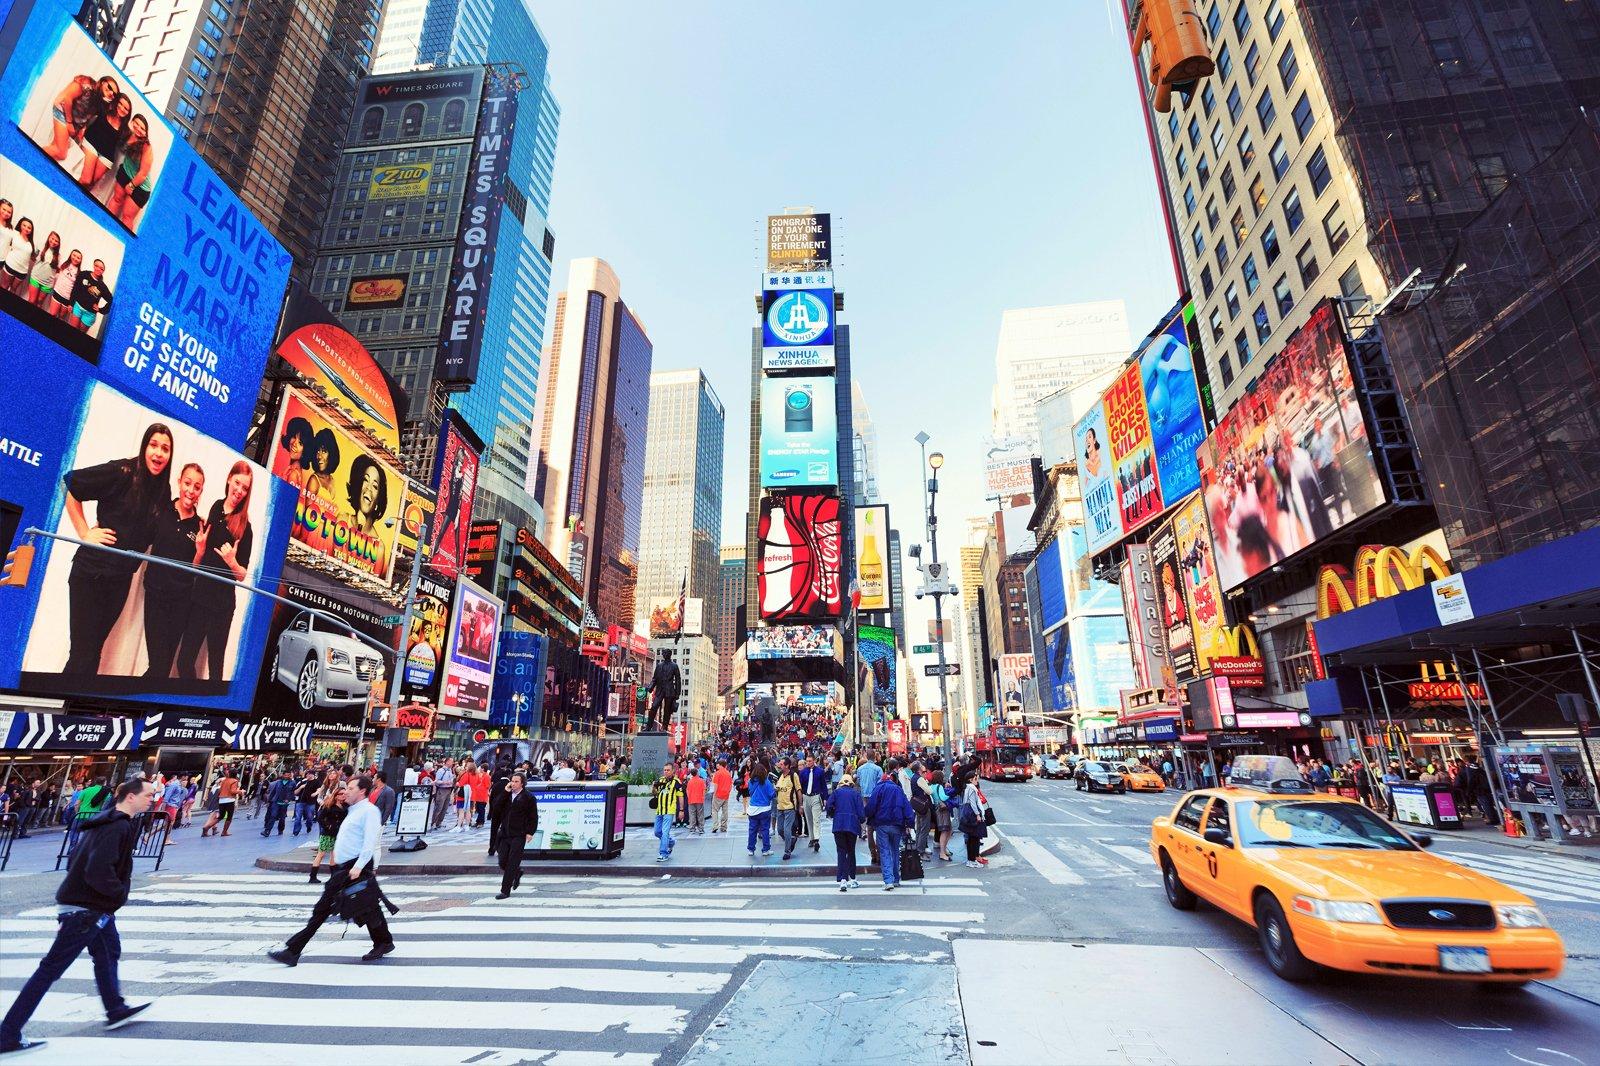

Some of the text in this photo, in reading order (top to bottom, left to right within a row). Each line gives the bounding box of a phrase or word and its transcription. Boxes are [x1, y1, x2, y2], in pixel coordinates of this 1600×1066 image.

[377, 81, 464, 95] W TIMES SQUARE
[475, 96, 507, 194] TIMES
[381, 168, 422, 184] Z100
[181, 160, 273, 275] LEAVE
[771, 217, 817, 227] CONGRATS
[771, 225, 823, 235] ON DAY ONE
[771, 233, 808, 242] OF YOUR
[771, 249, 808, 259] CLINTON
[182, 213, 260, 316] YOUR
[450, 205, 488, 341] SQUARE
[151, 253, 251, 352] MARK
[139, 302, 218, 373] GET YOUR
[784, 331, 817, 341] XINHUA
[312, 333, 347, 368] IMPORTED
[347, 366, 364, 385] FROM
[445, 357, 464, 366] NYC
[778, 350, 820, 360] XINHUA
[794, 358, 829, 366] AGENCY
[133, 324, 231, 404] 15 SECONDS
[123, 346, 200, 410] OF FAME.
[1105, 365, 1140, 415] THE
[1108, 389, 1142, 428] CROWD
[1110, 403, 1145, 445] GOES
[1112, 420, 1148, 462] WILD!
[1159, 428, 1204, 469] PHANTOM
[987, 458, 1031, 471] BEST MUSIC
[1012, 465, 1033, 475] BES
[1007, 480, 1033, 489] CENTU
[302, 488, 338, 513] BROADWAY
[405, 489, 436, 514] venue
[472, 525, 498, 533] REUTERS
[764, 553, 793, 563] refresh
[422, 580, 434, 594] JOY
[288, 586, 327, 606] CHRYSLER
[328, 600, 341, 611] 300
[343, 606, 370, 621] MOTOWN
[1137, 551, 1164, 658] PALACE
[1214, 661, 1263, 669] McDonald's
[605, 665, 635, 682] HEY'S
[78, 723, 107, 734] WE'RE
[164, 727, 217, 740] ENTER HERE
[274, 730, 290, 738] WE'RE
[313, 720, 376, 734] MotownTheMusic.com
[75, 732, 100, 742] OPEN
